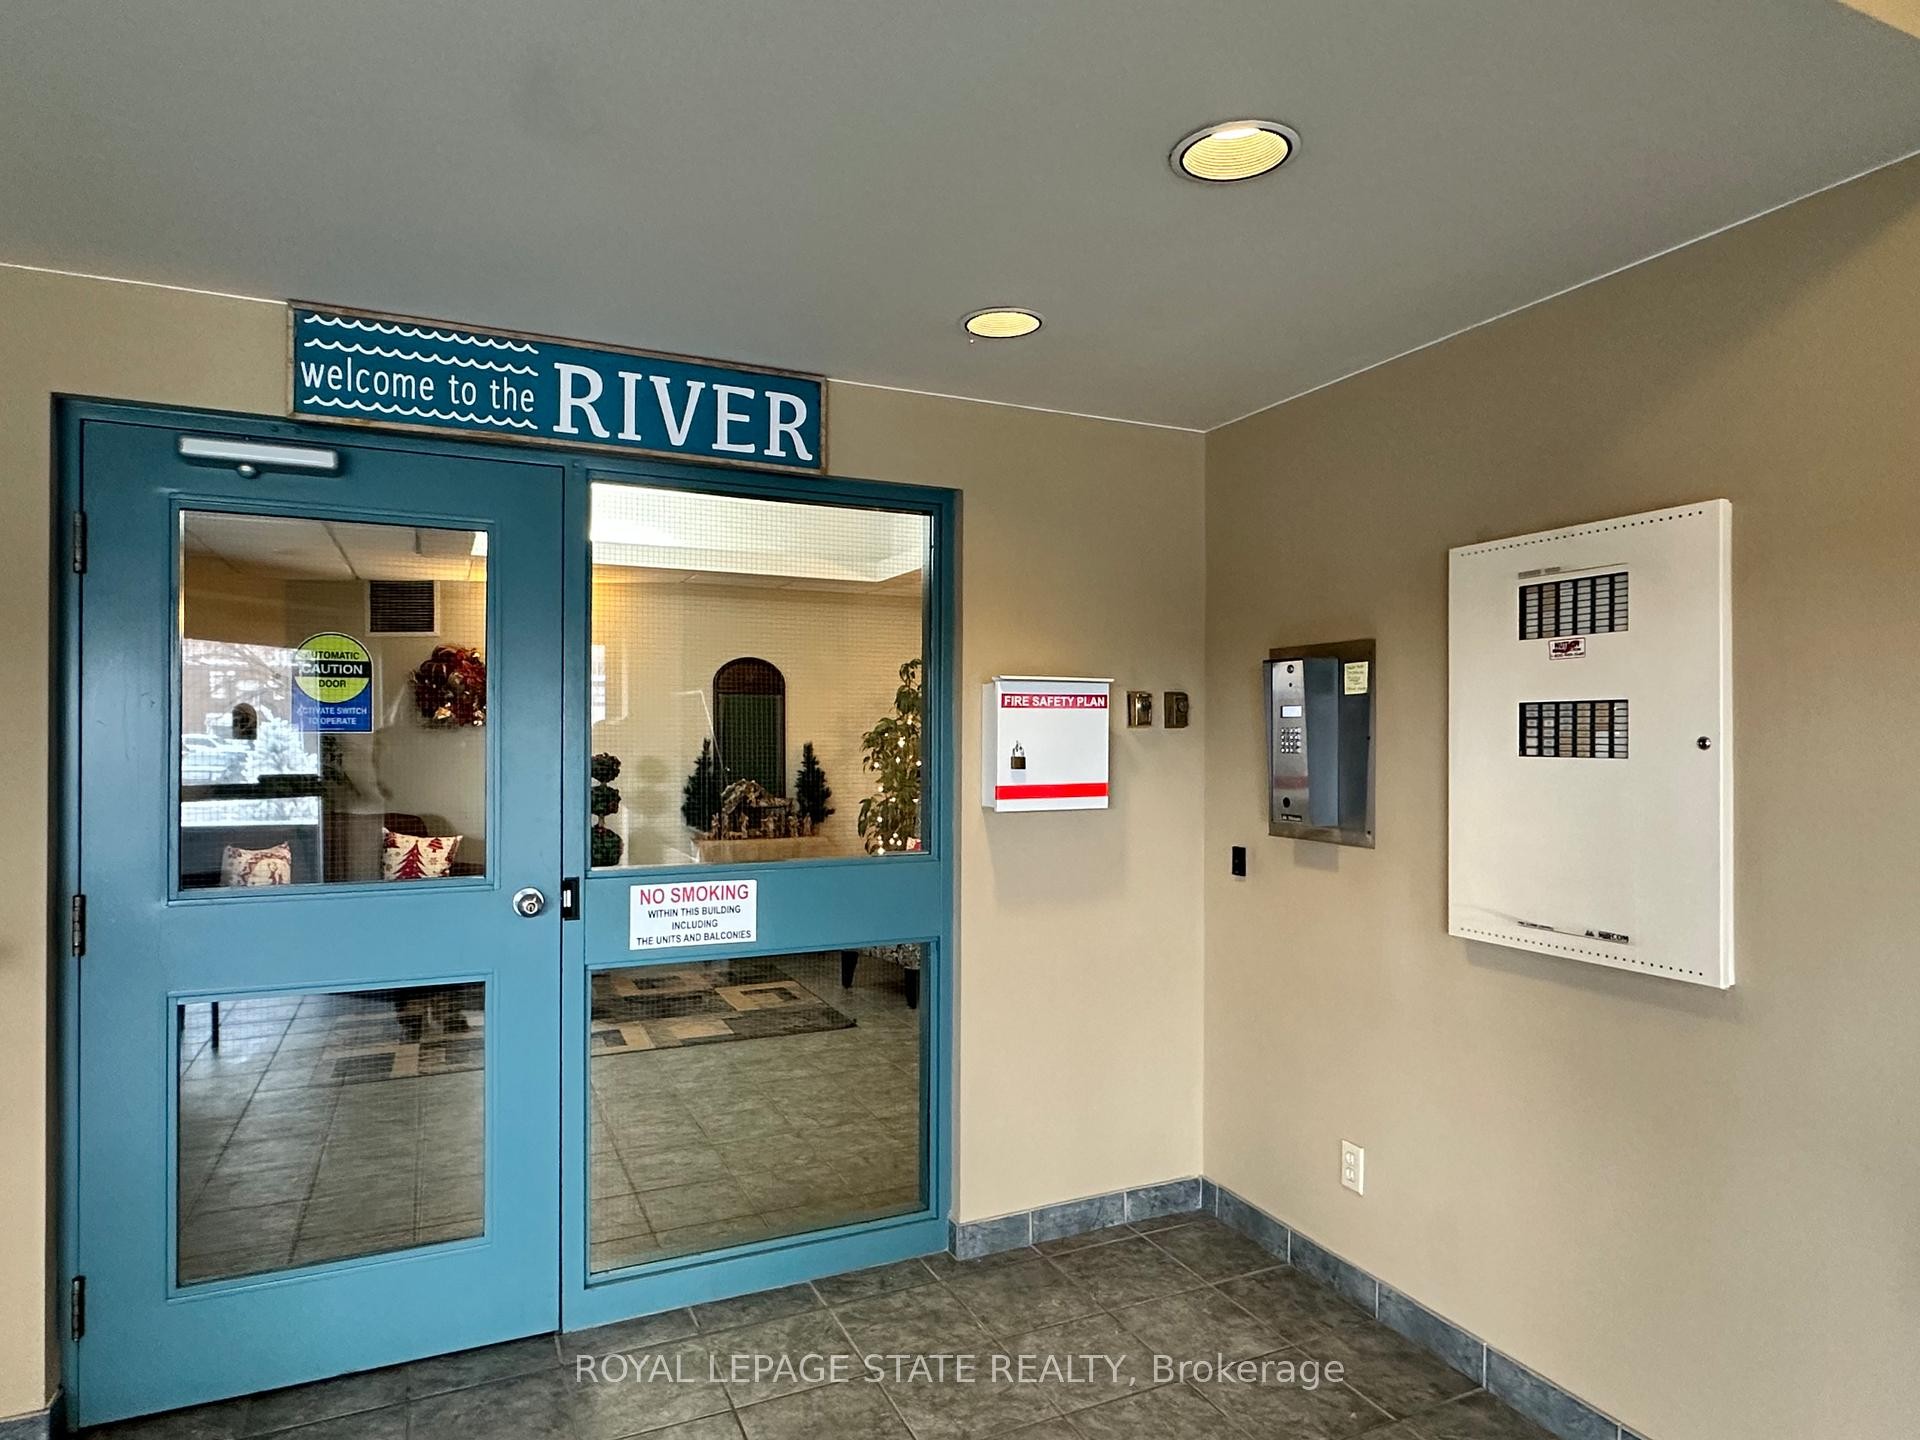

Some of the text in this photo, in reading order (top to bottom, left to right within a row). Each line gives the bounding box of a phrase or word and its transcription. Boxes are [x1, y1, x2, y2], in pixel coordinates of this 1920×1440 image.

[301, 357, 813, 461] welcome to the RIVER
[300, 664, 363, 675] CAUTION
[1004, 695, 1105, 707] FIRE SAFETY PLAN
[336, 707, 367, 715] SWITCH
[320, 717, 357, 725] OPERATE
[640, 884, 749, 905] NO SMOKING
[648, 905, 741, 919] WITHIN THIS BUILDING
[671, 919, 719, 930] INCLUDING
[636, 930, 752, 946] THE UNITS AND BALCONIES
